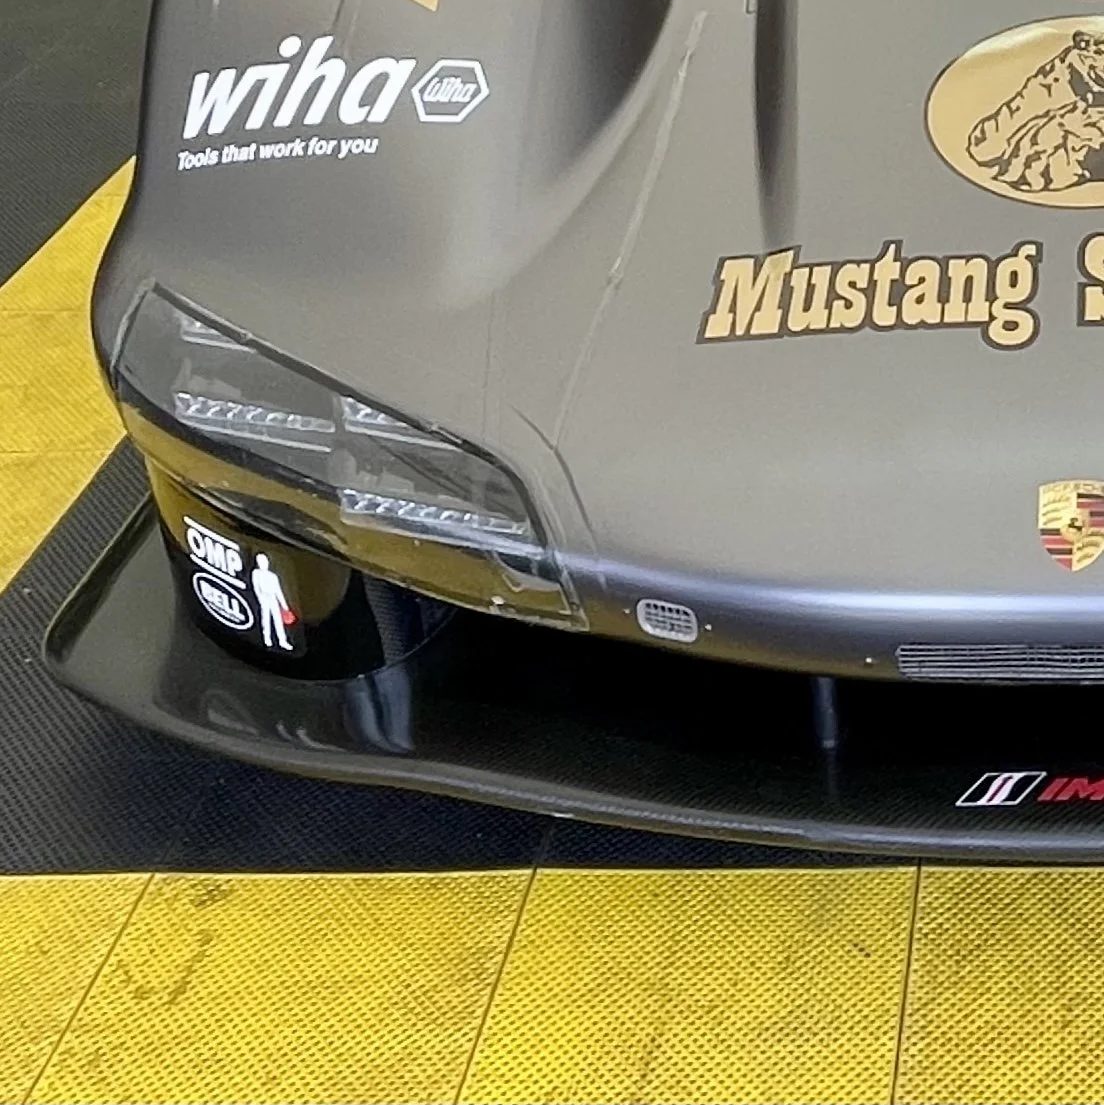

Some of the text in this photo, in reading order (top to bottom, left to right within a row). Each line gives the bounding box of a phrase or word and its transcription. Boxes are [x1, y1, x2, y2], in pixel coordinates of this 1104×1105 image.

[182, 35, 418, 140] wiha
[178, 136, 379, 171] Tools that work for you
[698, 241, 1040, 348] Mustang
[186, 527, 243, 576] OMP
